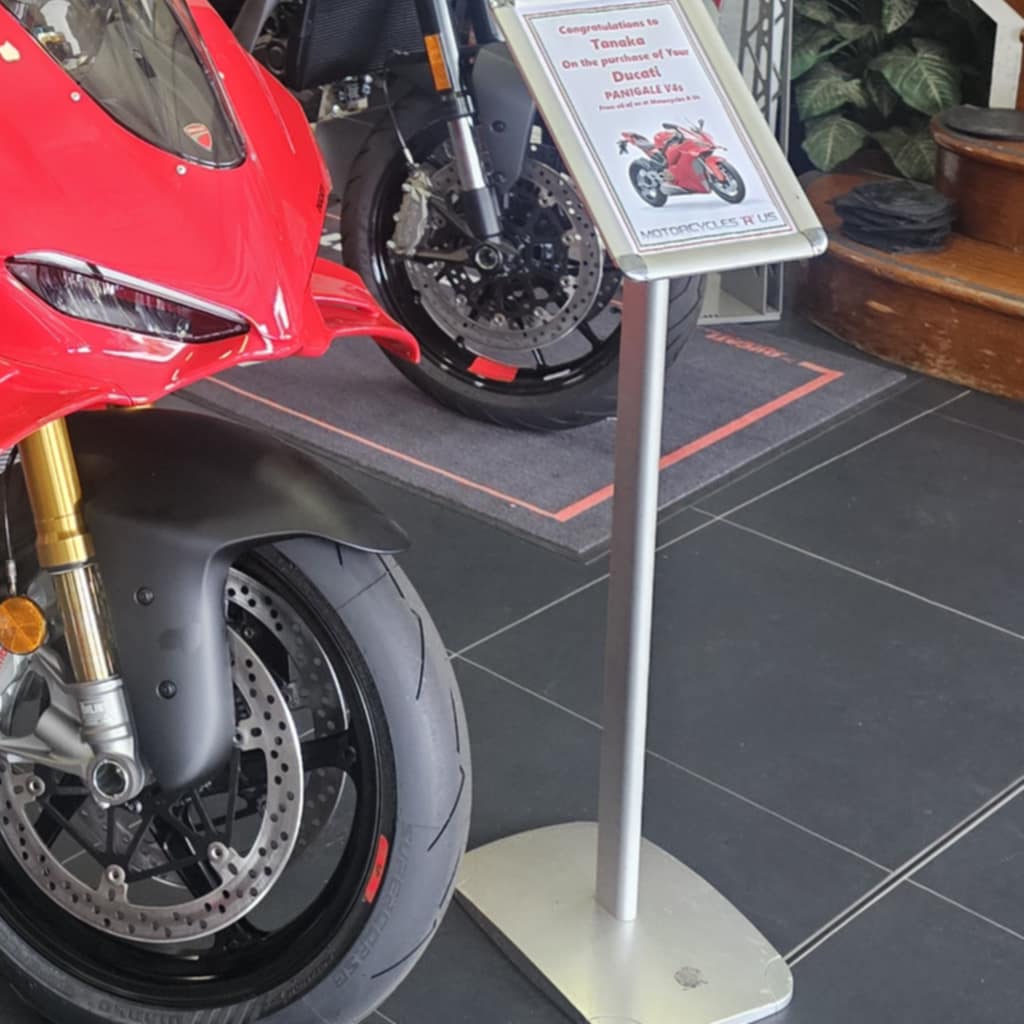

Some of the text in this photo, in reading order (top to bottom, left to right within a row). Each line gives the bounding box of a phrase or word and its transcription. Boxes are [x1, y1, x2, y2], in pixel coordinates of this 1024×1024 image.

[558, 18, 659, 35] Congratulations to
[590, 36, 646, 50] Tanaka
[562, 48, 689, 69] On the purchase of Your
[611, 66, 662, 82] Ducati
[604, 85, 662, 100] PANIGALE
[640, 218, 738, 240] MOTORCYCLES
[757, 211, 779, 223] US
